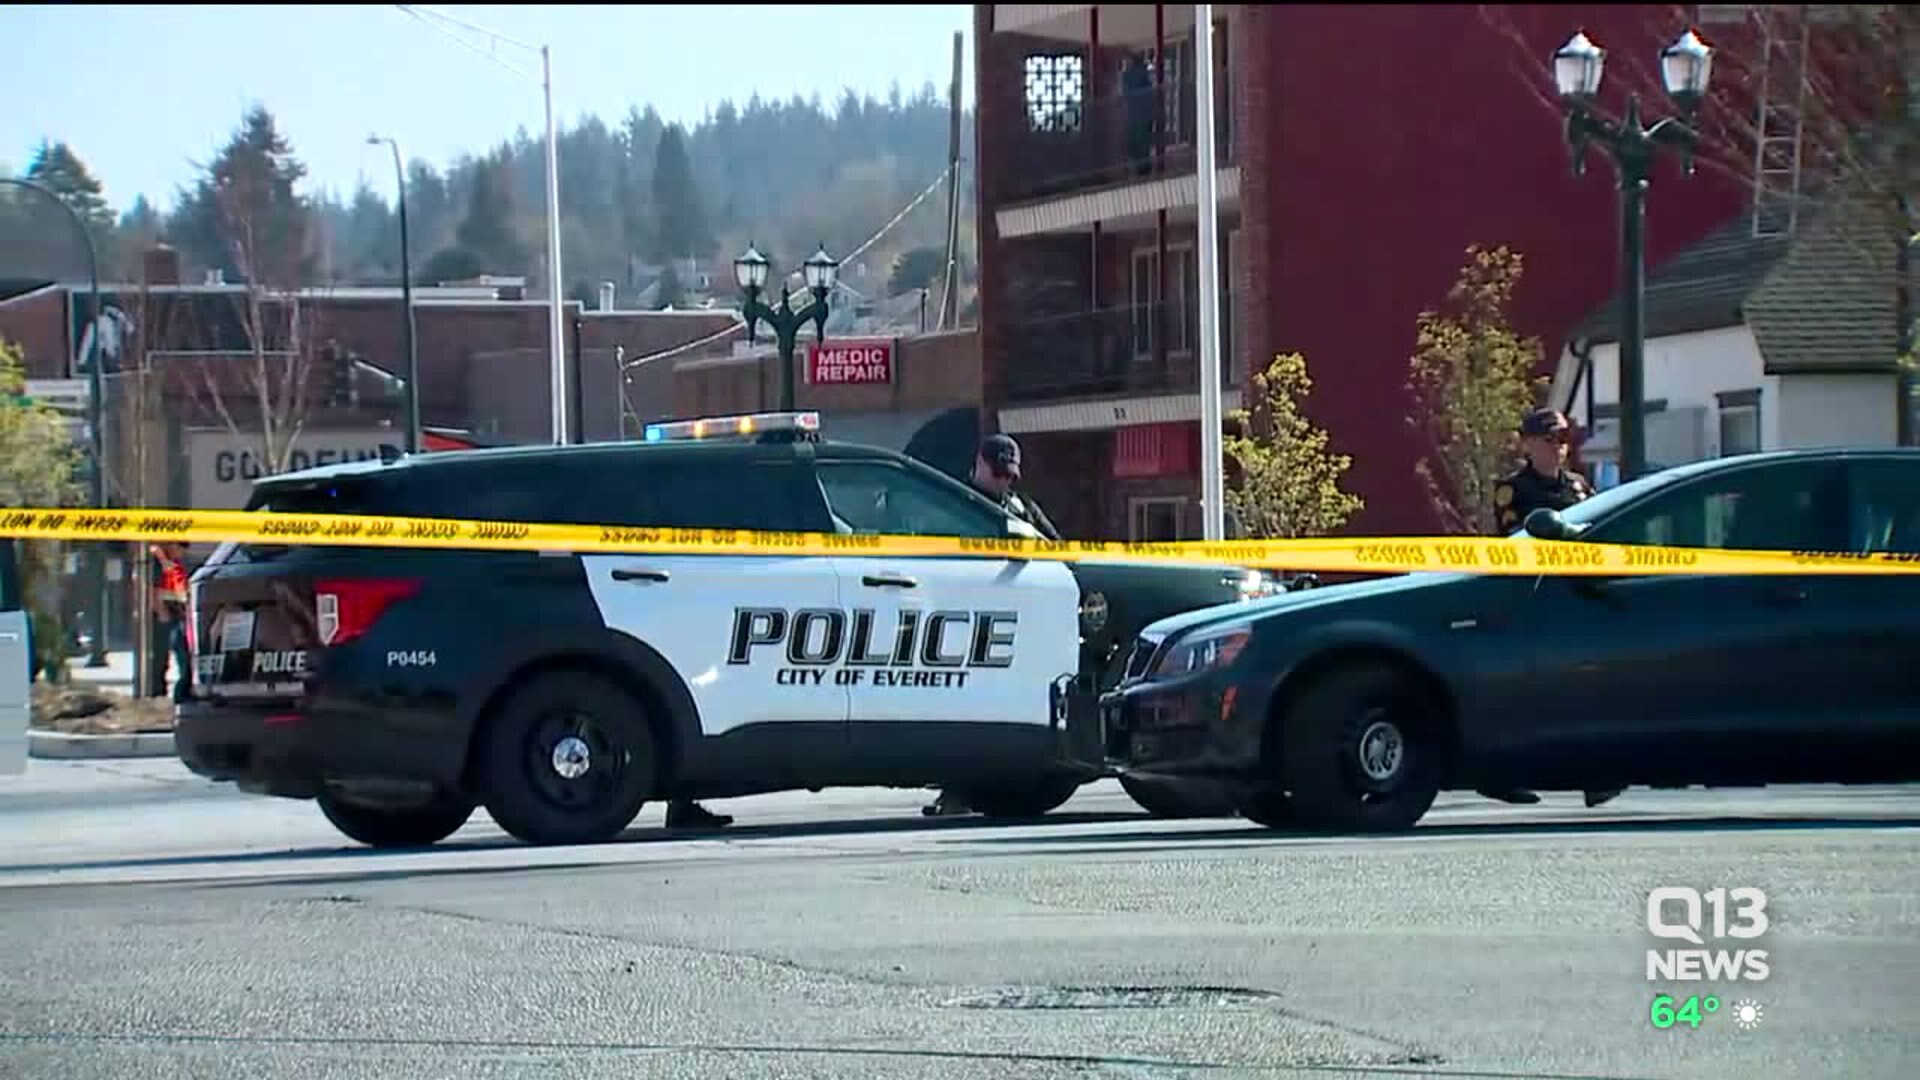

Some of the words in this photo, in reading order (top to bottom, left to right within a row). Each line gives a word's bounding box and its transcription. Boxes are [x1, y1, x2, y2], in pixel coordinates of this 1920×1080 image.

[818, 348, 883, 365] MEDIC
[815, 364, 887, 381] REPAIR
[727, 607, 1019, 668] POLICE
[253, 651, 308, 673] POLICE
[387, 650, 437, 667] P0454
[776, 668, 824, 686] CITY
[834, 669, 864, 686] OF
[872, 669, 970, 688] EVERETT
